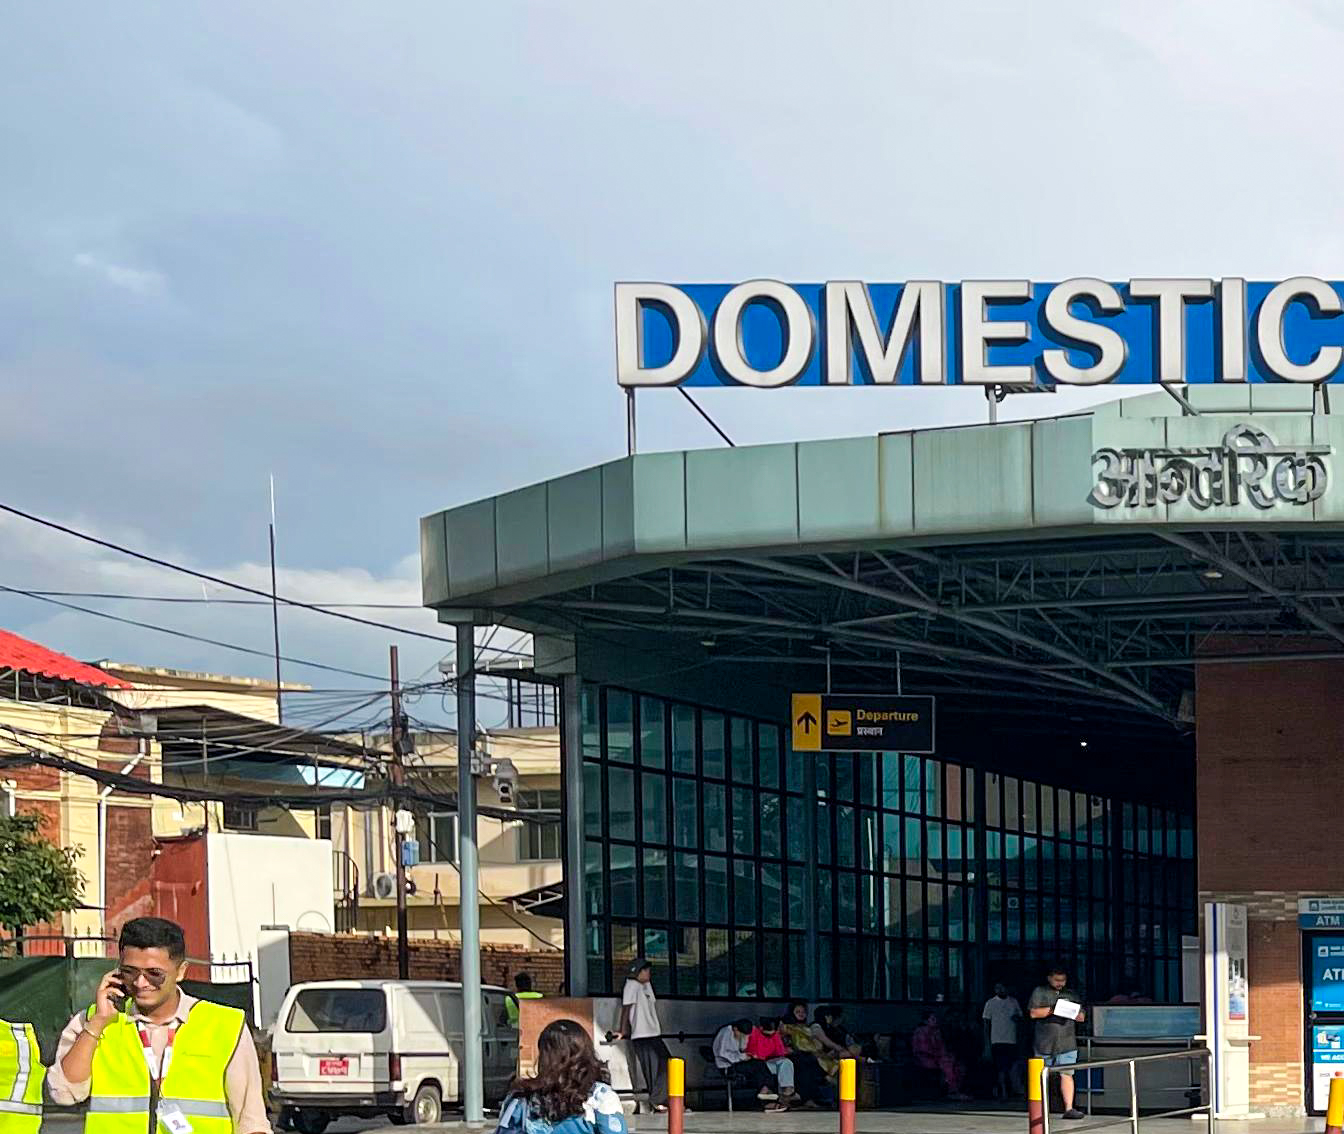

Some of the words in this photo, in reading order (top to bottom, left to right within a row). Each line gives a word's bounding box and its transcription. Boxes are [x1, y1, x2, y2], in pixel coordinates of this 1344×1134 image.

[614, 277, 1344, 388] DOMESTIC
[856, 709, 919, 723] Departure
[1315, 915, 1341, 926] ATM
